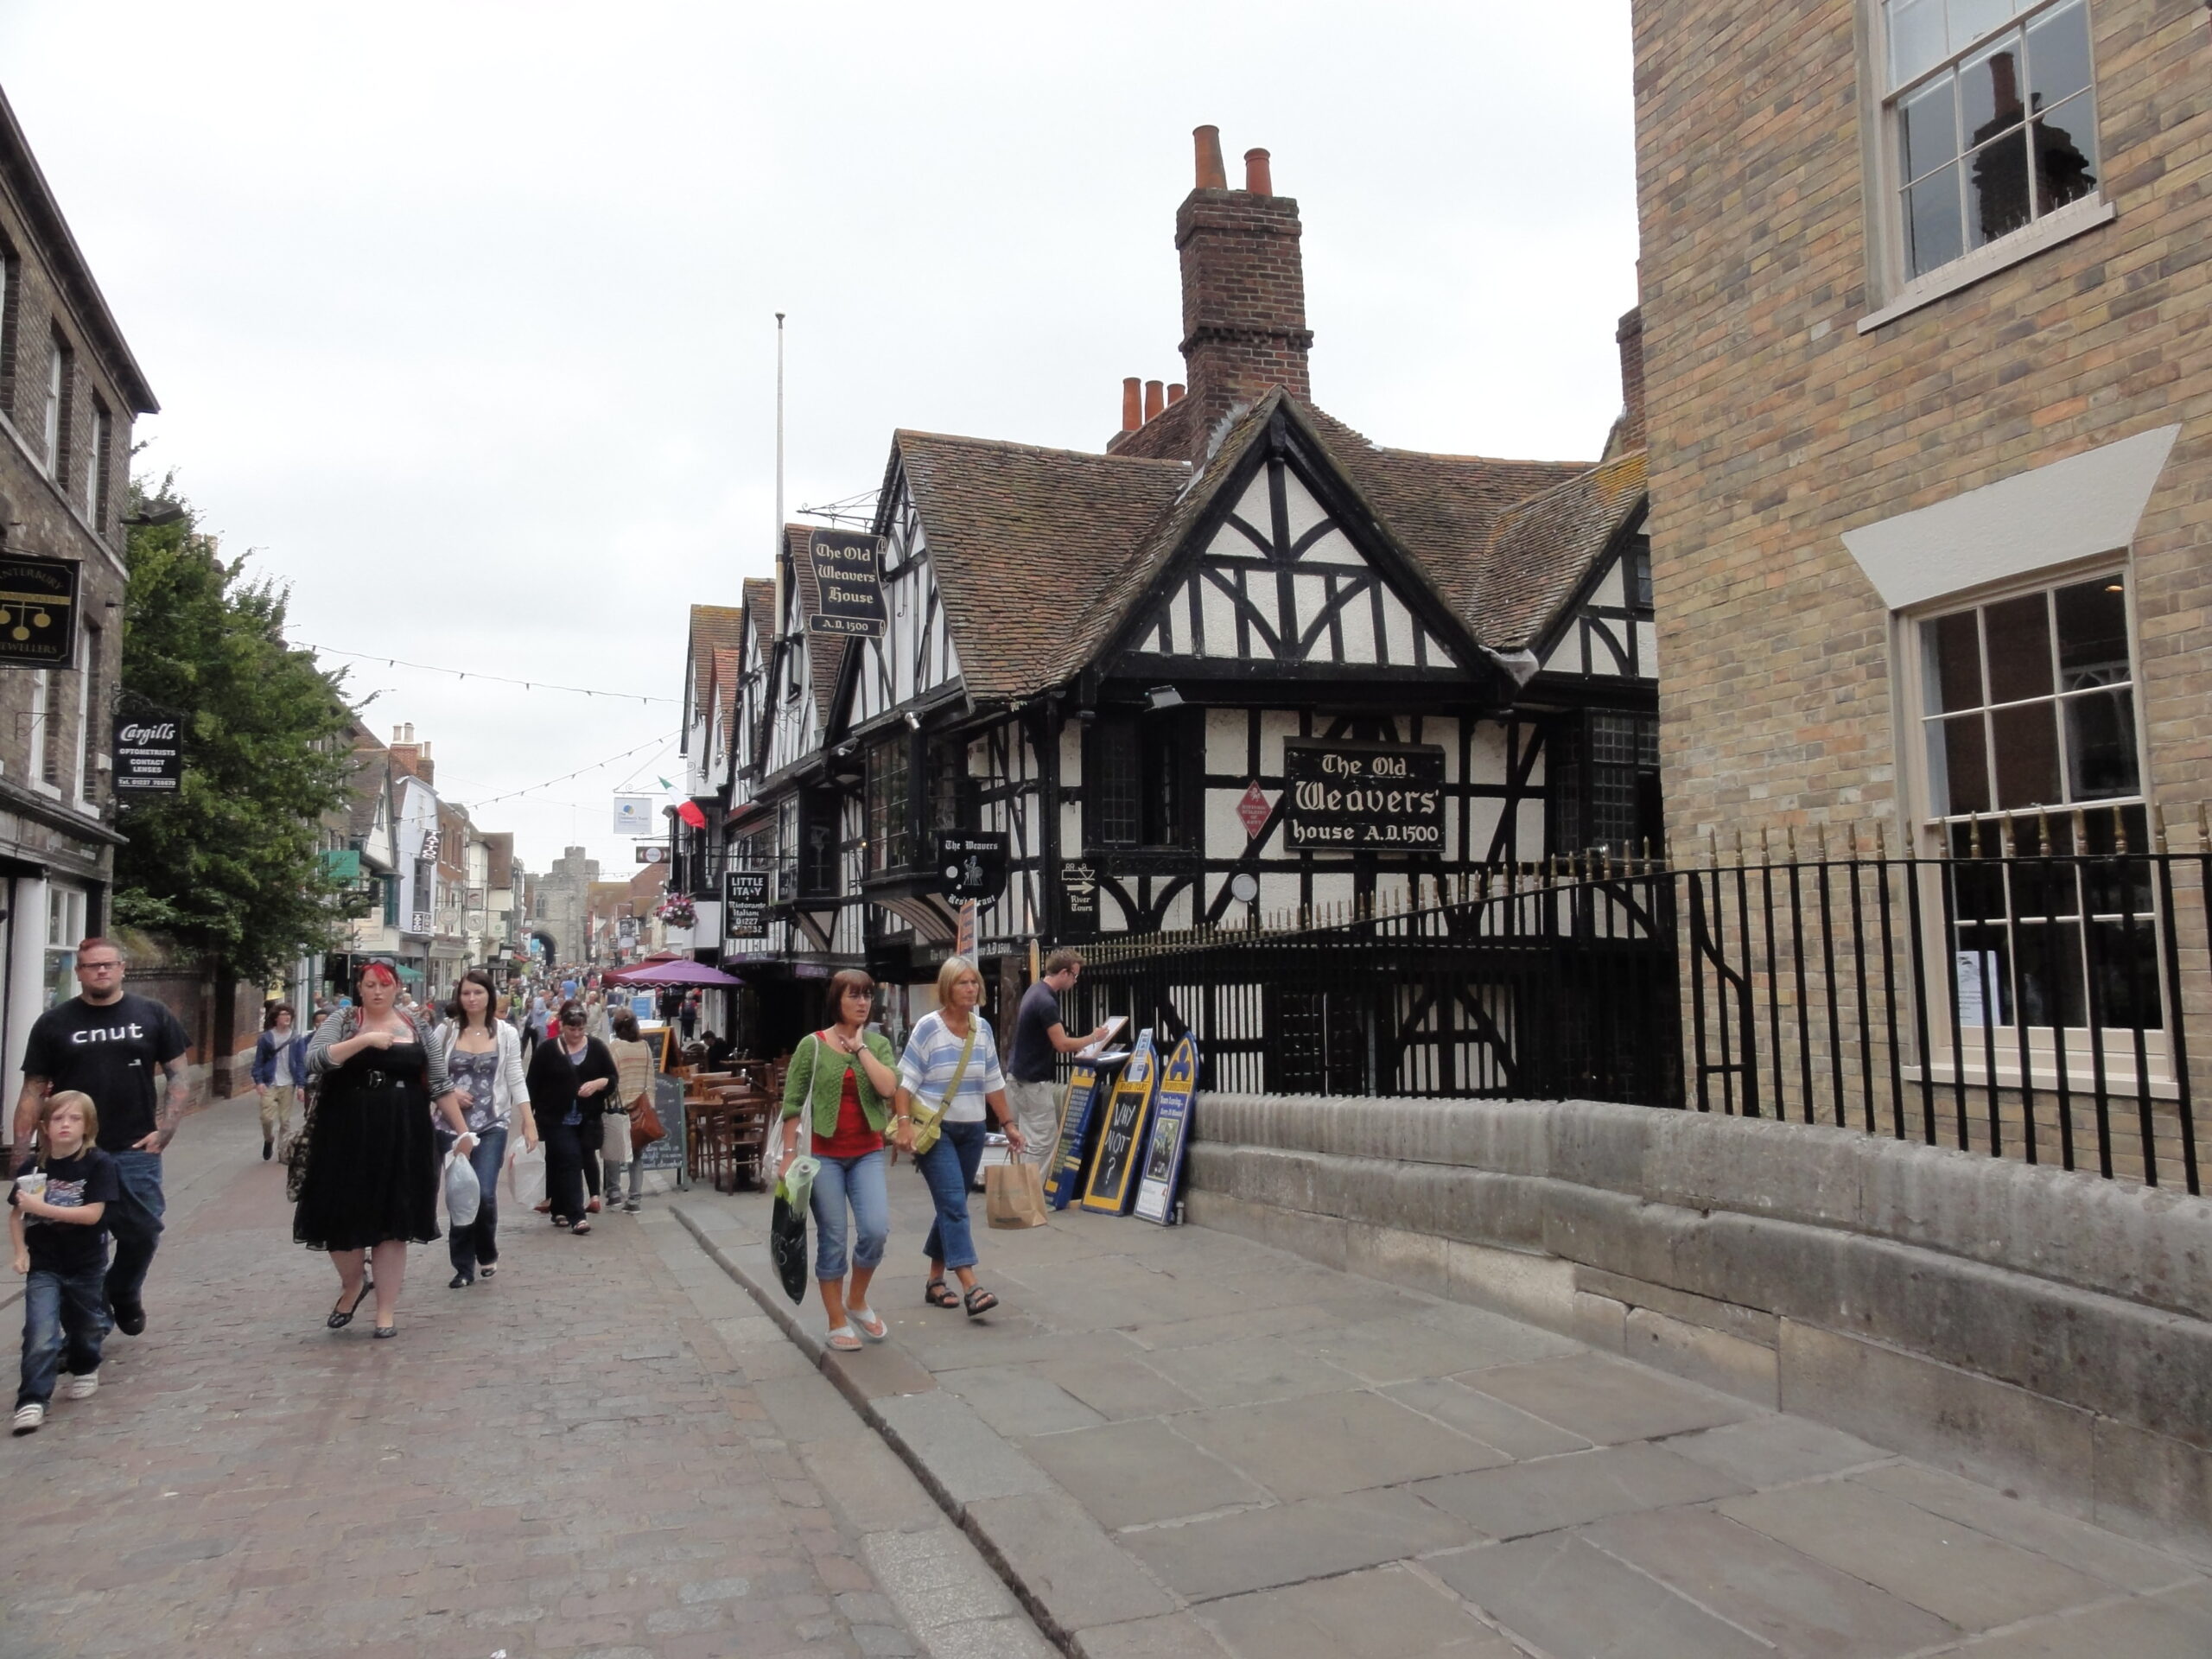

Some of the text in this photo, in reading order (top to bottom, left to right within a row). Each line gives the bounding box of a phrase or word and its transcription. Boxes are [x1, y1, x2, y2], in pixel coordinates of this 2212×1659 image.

[816, 543, 871, 562] The Old
[0, 568, 63, 589] NTERBURY
[818, 564, 876, 582] Weavers
[828, 587, 874, 604] House
[823, 620, 869, 632] A.D. 1500
[0, 641, 58, 654] EWELLERS
[120, 722, 176, 746] Cargills
[1322, 754, 1407, 779] The Old
[1293, 819, 1355, 842] house
[944, 840, 998, 851] The Weavers
[732, 877, 764, 887] LITTLE
[948, 893, 996, 908] Restrant
[73, 1023, 144, 1044] cnut
[1114, 1103, 1136, 1127] WHY
[1105, 1130, 1131, 1154] NOT
[1105, 1158, 1116, 1184] ?
